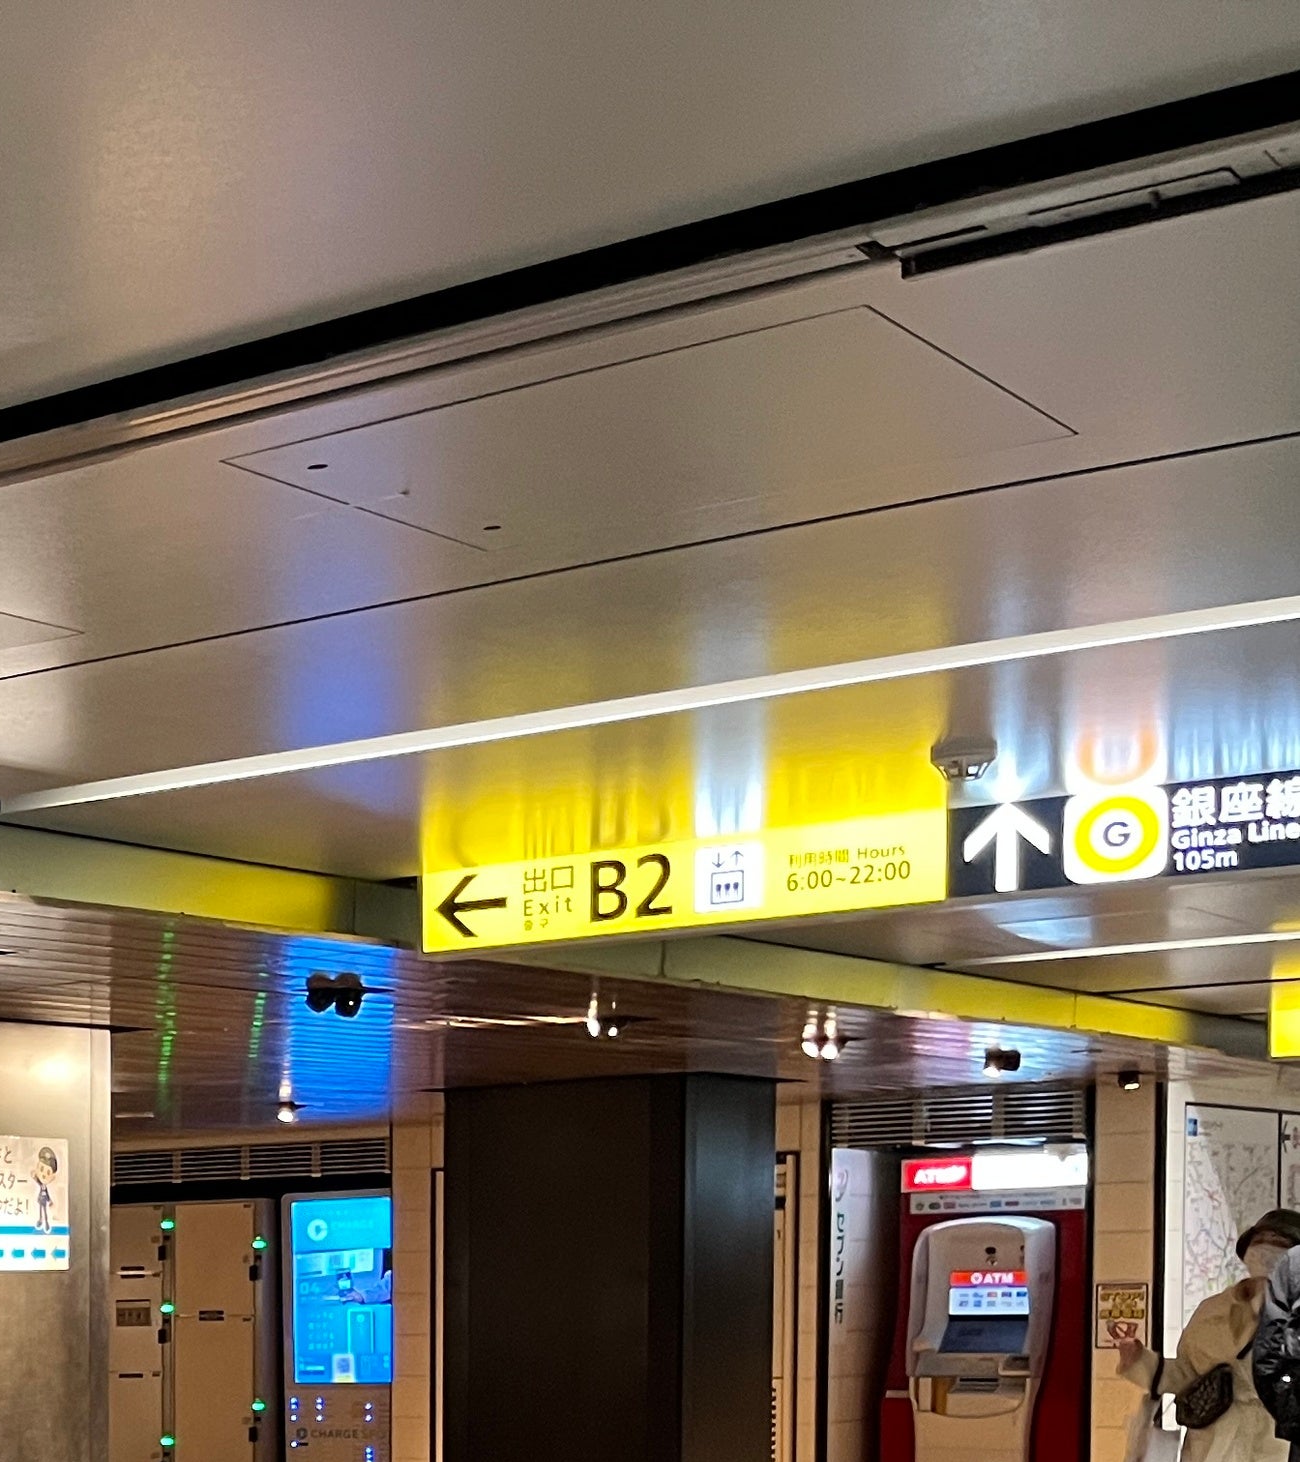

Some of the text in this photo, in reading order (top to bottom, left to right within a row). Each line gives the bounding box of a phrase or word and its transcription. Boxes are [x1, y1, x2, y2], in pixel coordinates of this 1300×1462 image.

[1103, 821, 1131, 847] G
[1171, 815, 1300, 849] Ginza Line
[857, 845, 905, 860] Hours
[1172, 847, 1238, 872] 105m
[523, 865, 574, 895] 出口
[590, 853, 673, 923] B2
[523, 895, 573, 917] Exit
[983, 1271, 1015, 1285] ATM
